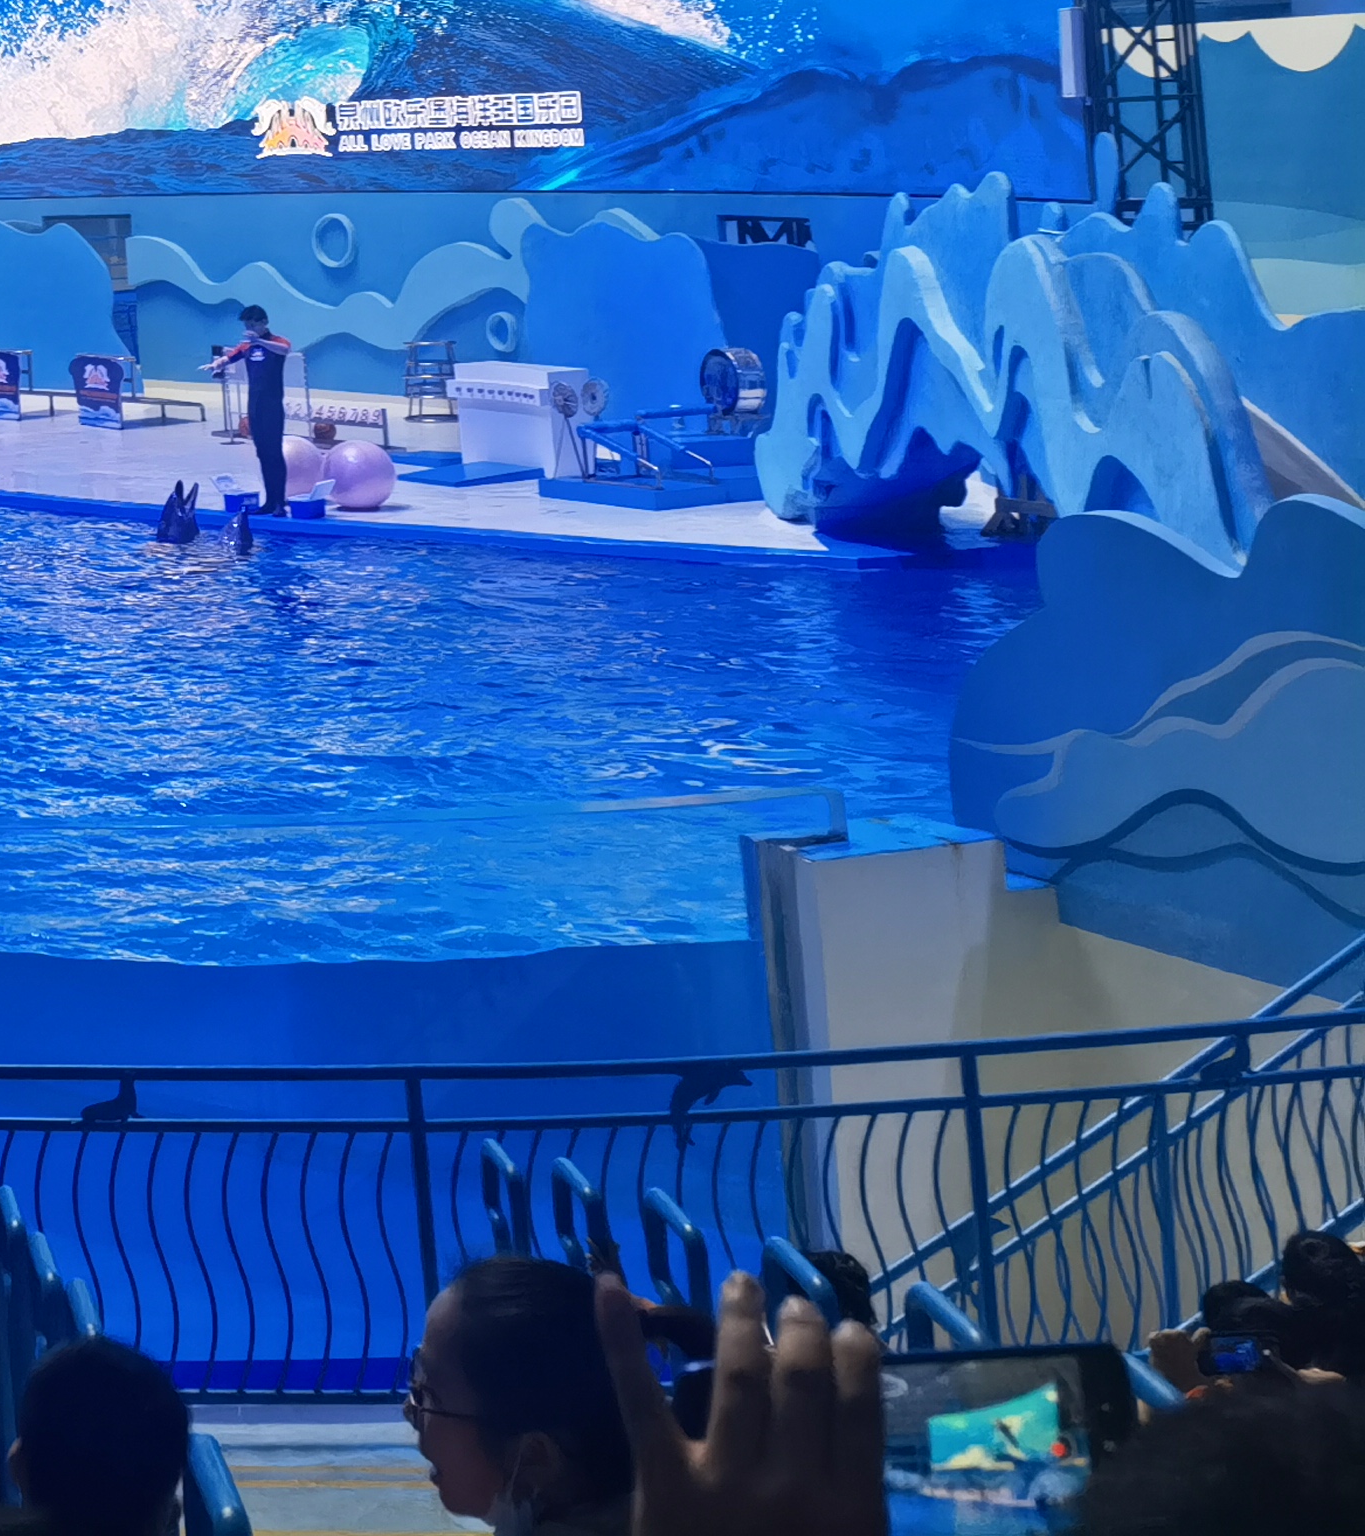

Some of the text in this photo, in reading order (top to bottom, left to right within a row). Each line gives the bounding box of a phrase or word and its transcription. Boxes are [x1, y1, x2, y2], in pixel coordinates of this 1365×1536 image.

[338, 128, 585, 152] ALL LOVE PARK OCEAN KINGDOM
